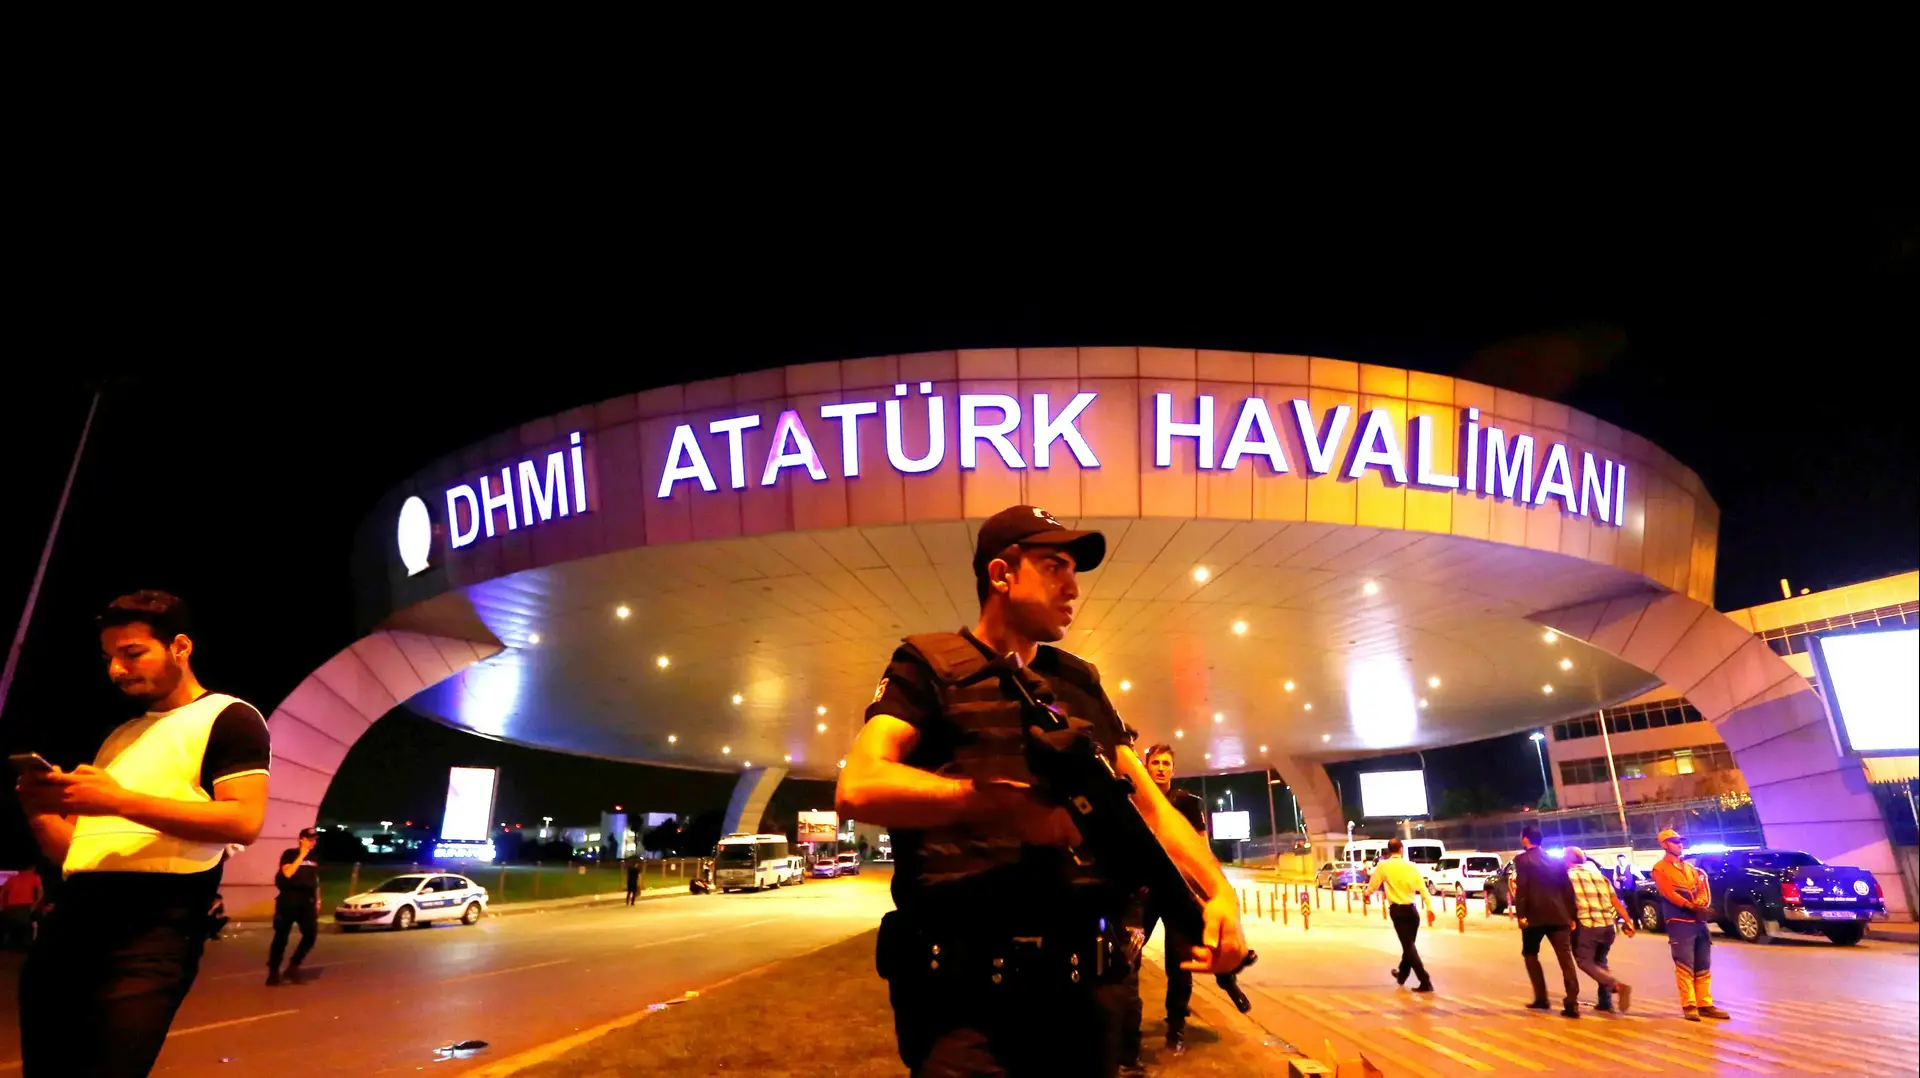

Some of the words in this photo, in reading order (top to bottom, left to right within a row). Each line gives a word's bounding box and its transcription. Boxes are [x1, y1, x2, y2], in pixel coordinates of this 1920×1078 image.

[446, 431, 587, 549] DHMİ
[657, 381, 1100, 499] ATATÜRK
[1155, 393, 1627, 528] HAVALİMANI
